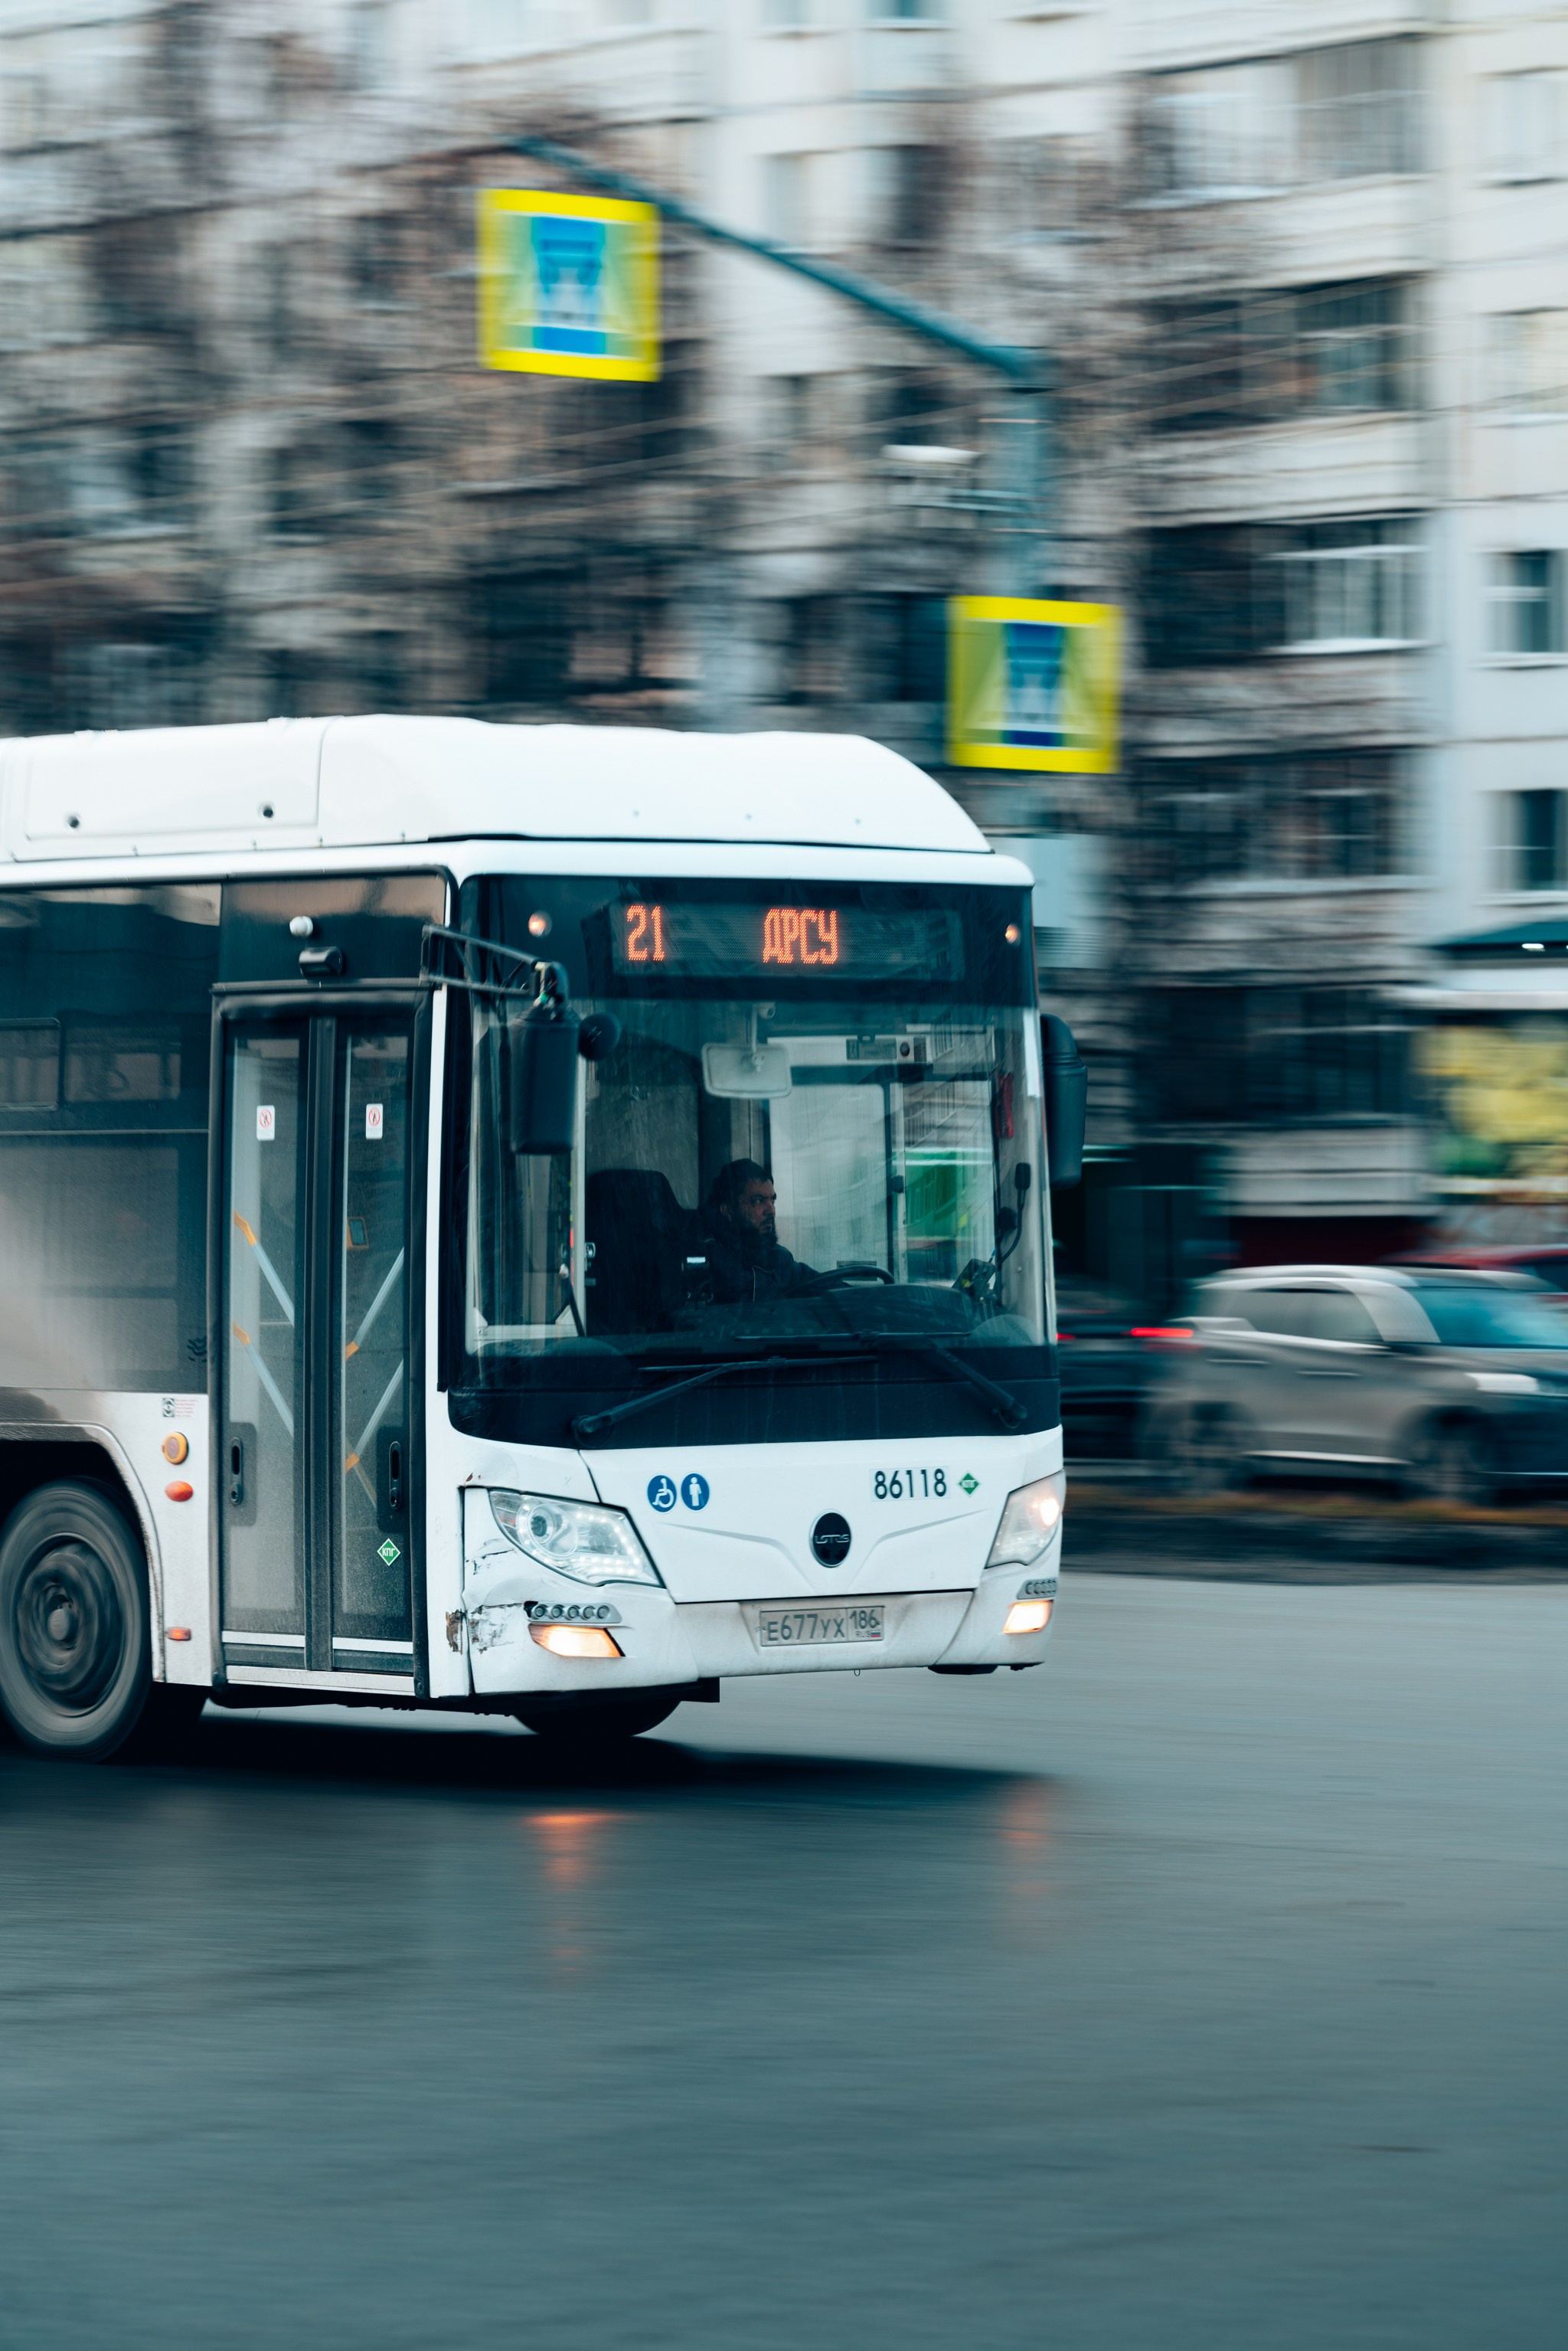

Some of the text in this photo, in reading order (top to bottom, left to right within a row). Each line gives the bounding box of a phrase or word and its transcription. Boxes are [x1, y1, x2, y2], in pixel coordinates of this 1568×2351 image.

[626, 905, 839, 964] 21 ДРСУ
[874, 1468, 947, 1499] 86118
[382, 1547, 396, 1557] КПГ
[849, 1609, 878, 1630] 186
